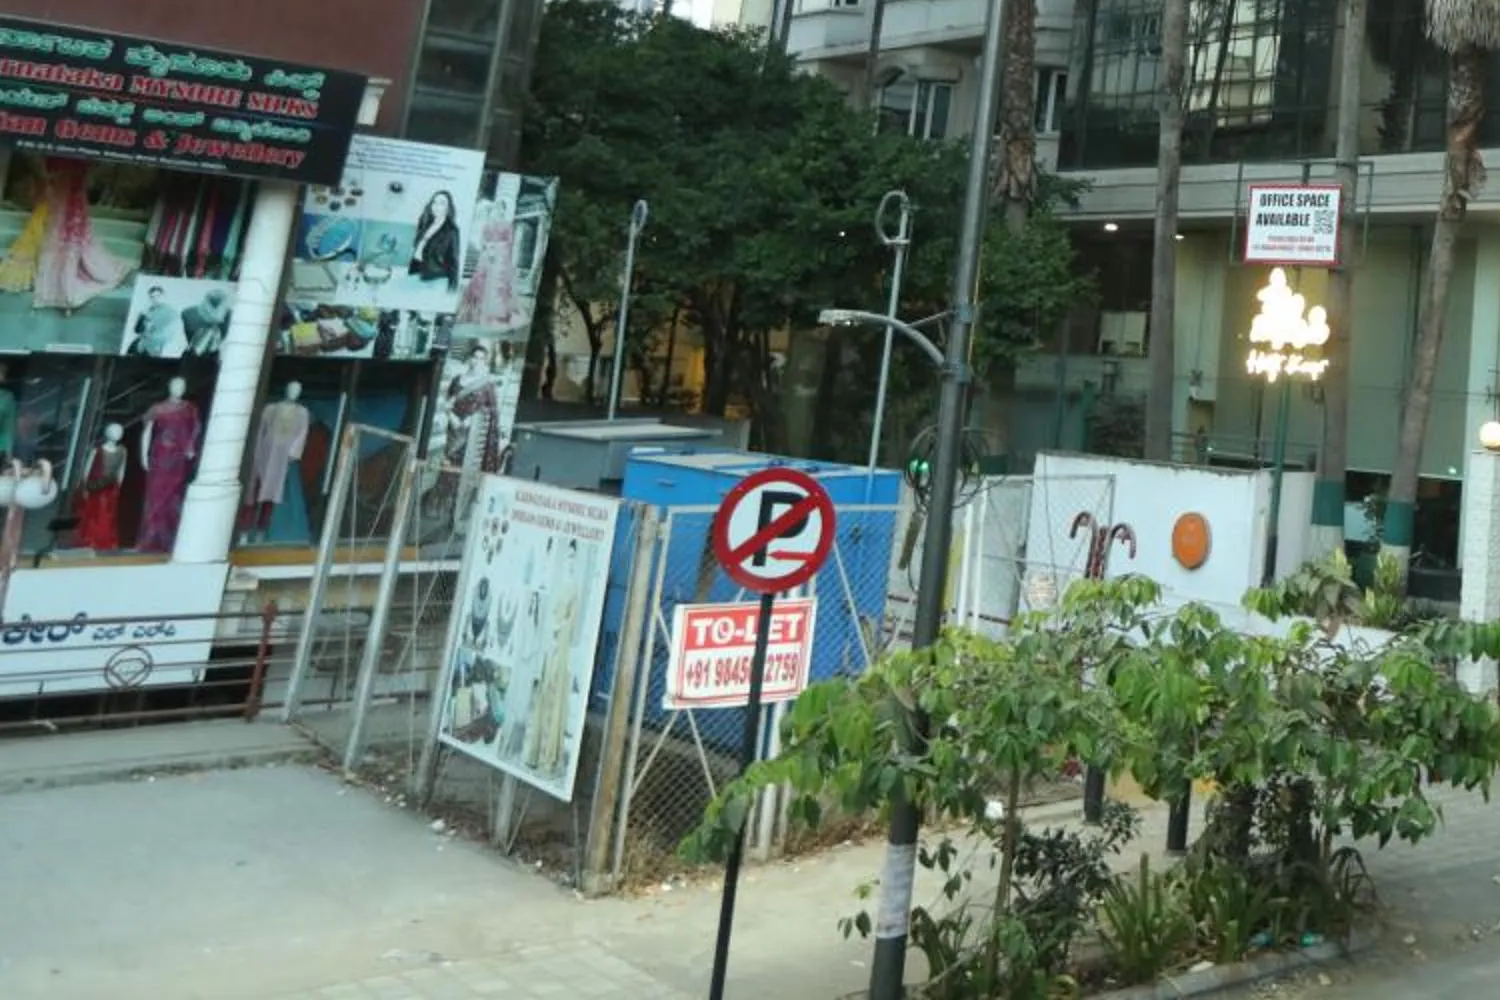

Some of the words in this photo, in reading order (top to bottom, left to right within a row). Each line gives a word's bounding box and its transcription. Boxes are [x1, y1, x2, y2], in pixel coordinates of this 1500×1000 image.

[129, 74, 243, 109] MYSORE
[246, 91, 319, 120] SILKS
[143, 128, 168, 150] &
[1259, 193, 1295, 207] OFFICE
[1296, 193, 1331, 208] SPACE
[1255, 212, 1311, 227] AVAILABLE
[691, 612, 804, 647] TO-LET
[715, 654, 798, 686] 98452759
